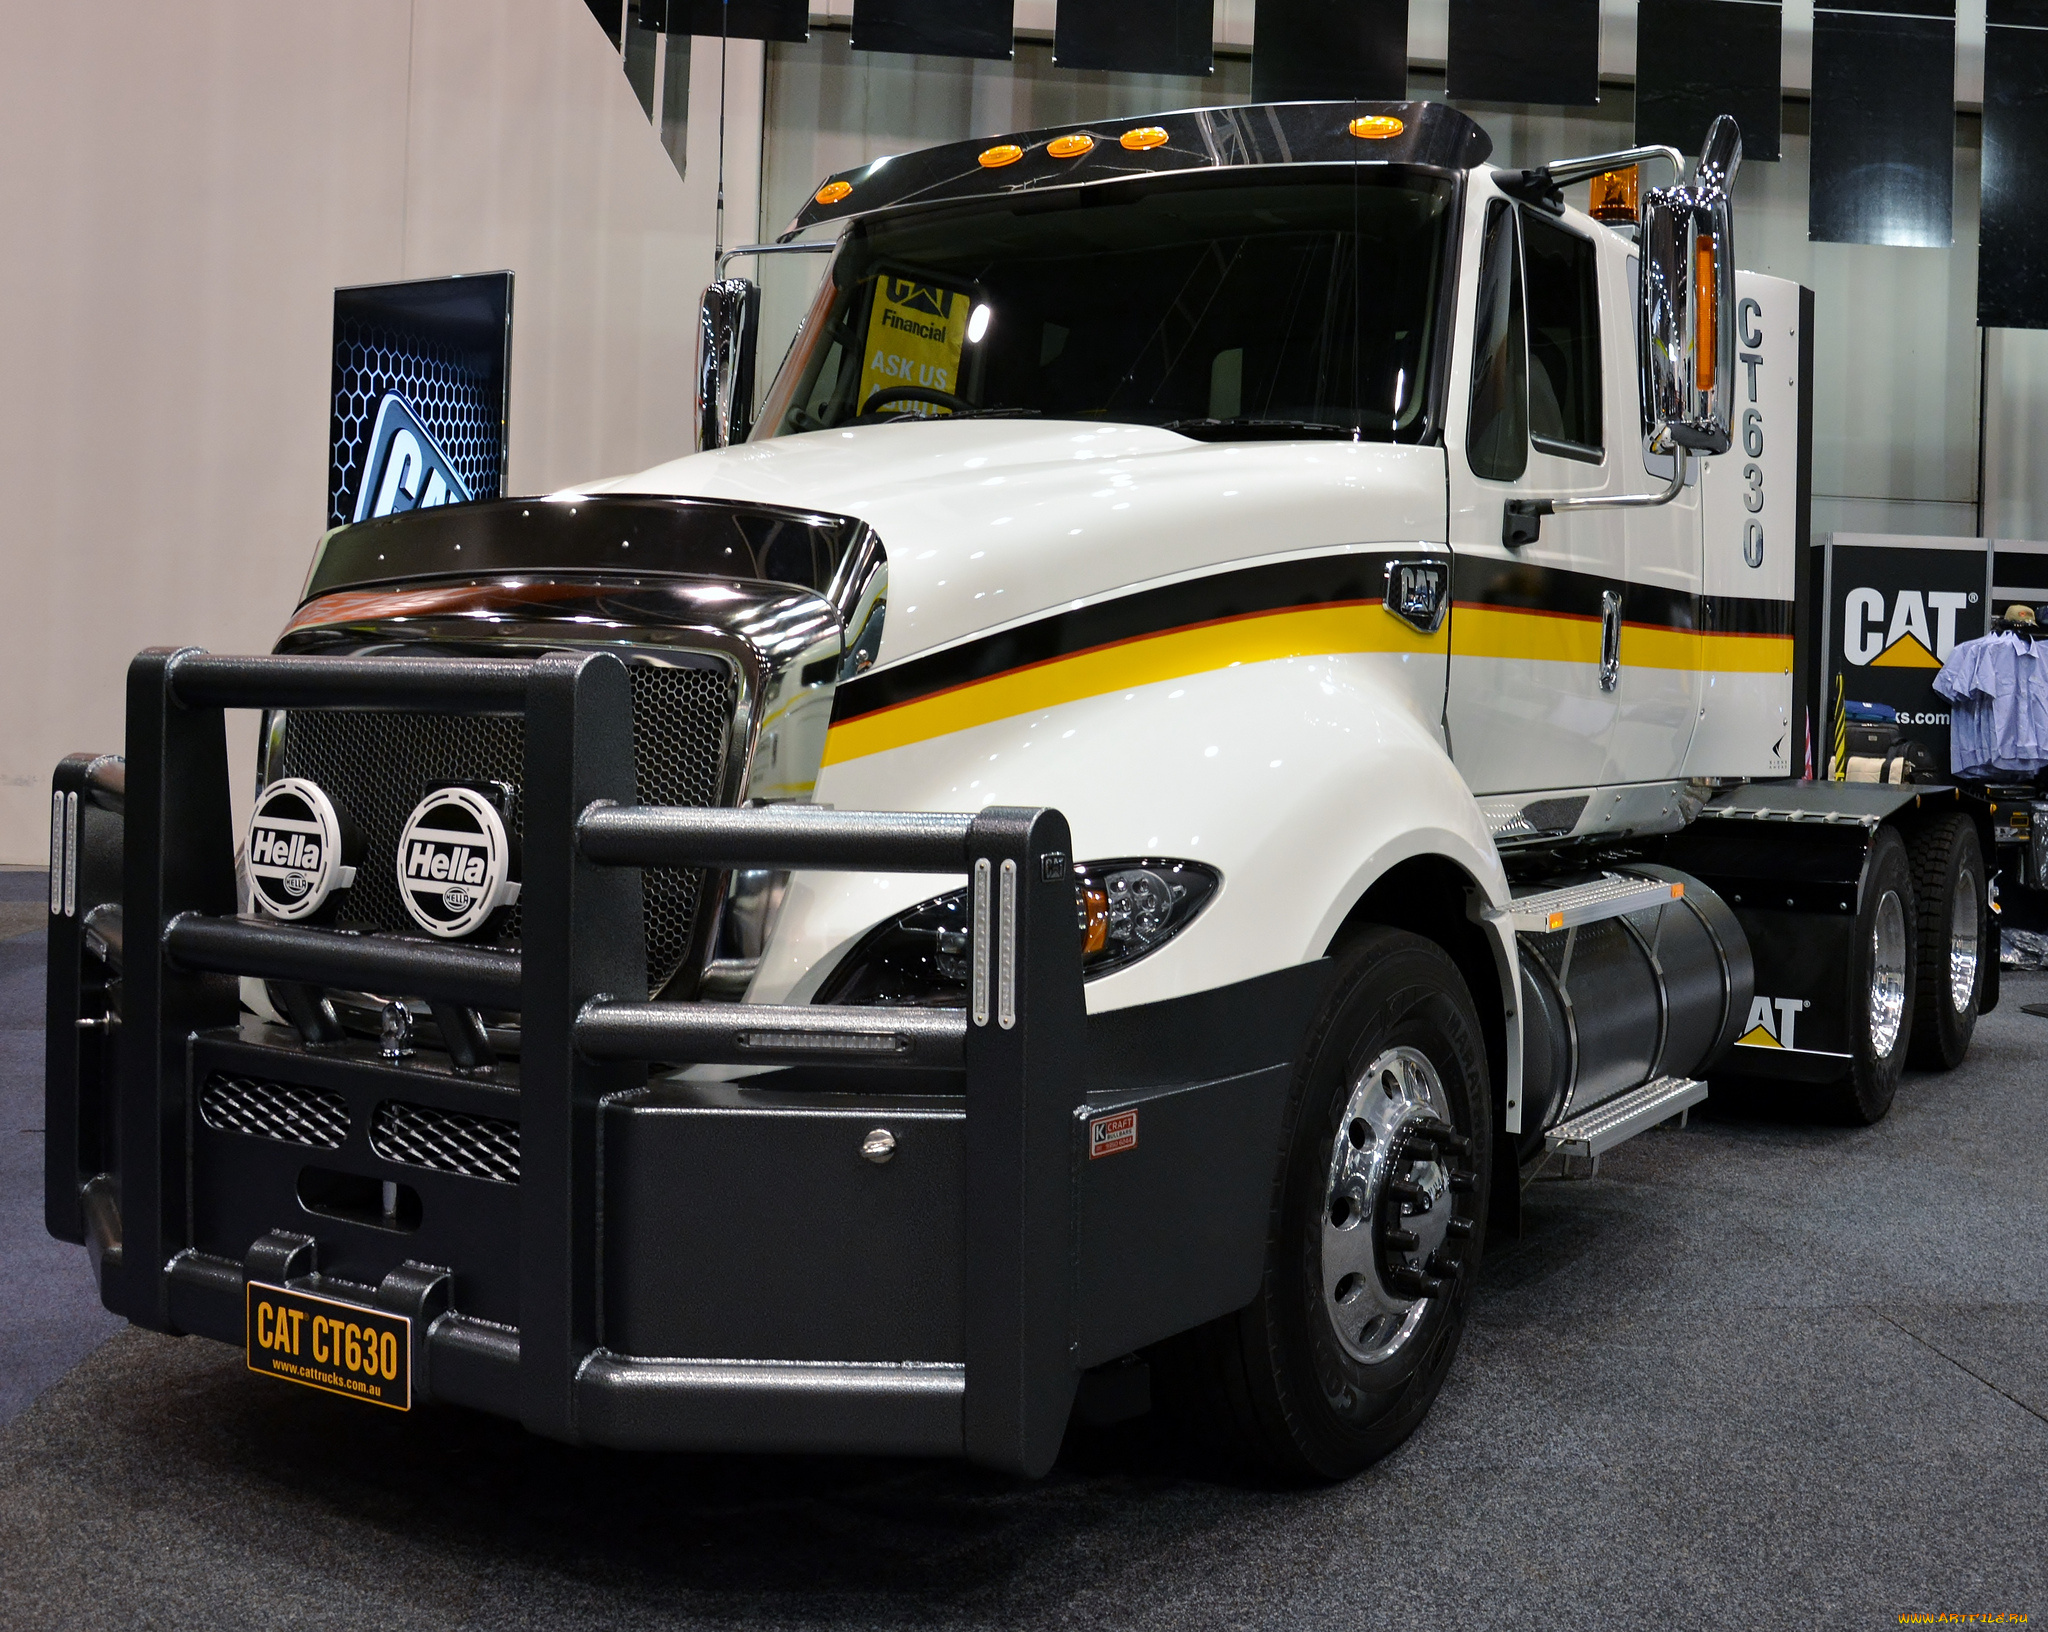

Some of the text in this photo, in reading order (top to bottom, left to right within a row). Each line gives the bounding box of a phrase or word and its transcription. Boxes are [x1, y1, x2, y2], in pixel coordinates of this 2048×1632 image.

[882, 308, 947, 343] Financial
[871, 350, 948, 390] ASK US
[1738, 297, 1763, 569] CT630
[1400, 566, 1439, 615] CAT
[1844, 587, 1967, 667] CAT
[253, 830, 320, 870] Hella
[407, 842, 486, 884] Hella
[286, 878, 307, 890] HELLA
[446, 894, 469, 905] HELLA
[1095, 1117, 1133, 1142] K CRAFT
[257, 1301, 397, 1381] CAT CT630
[272, 1359, 382, 1397] www.cattrucks.com.au
